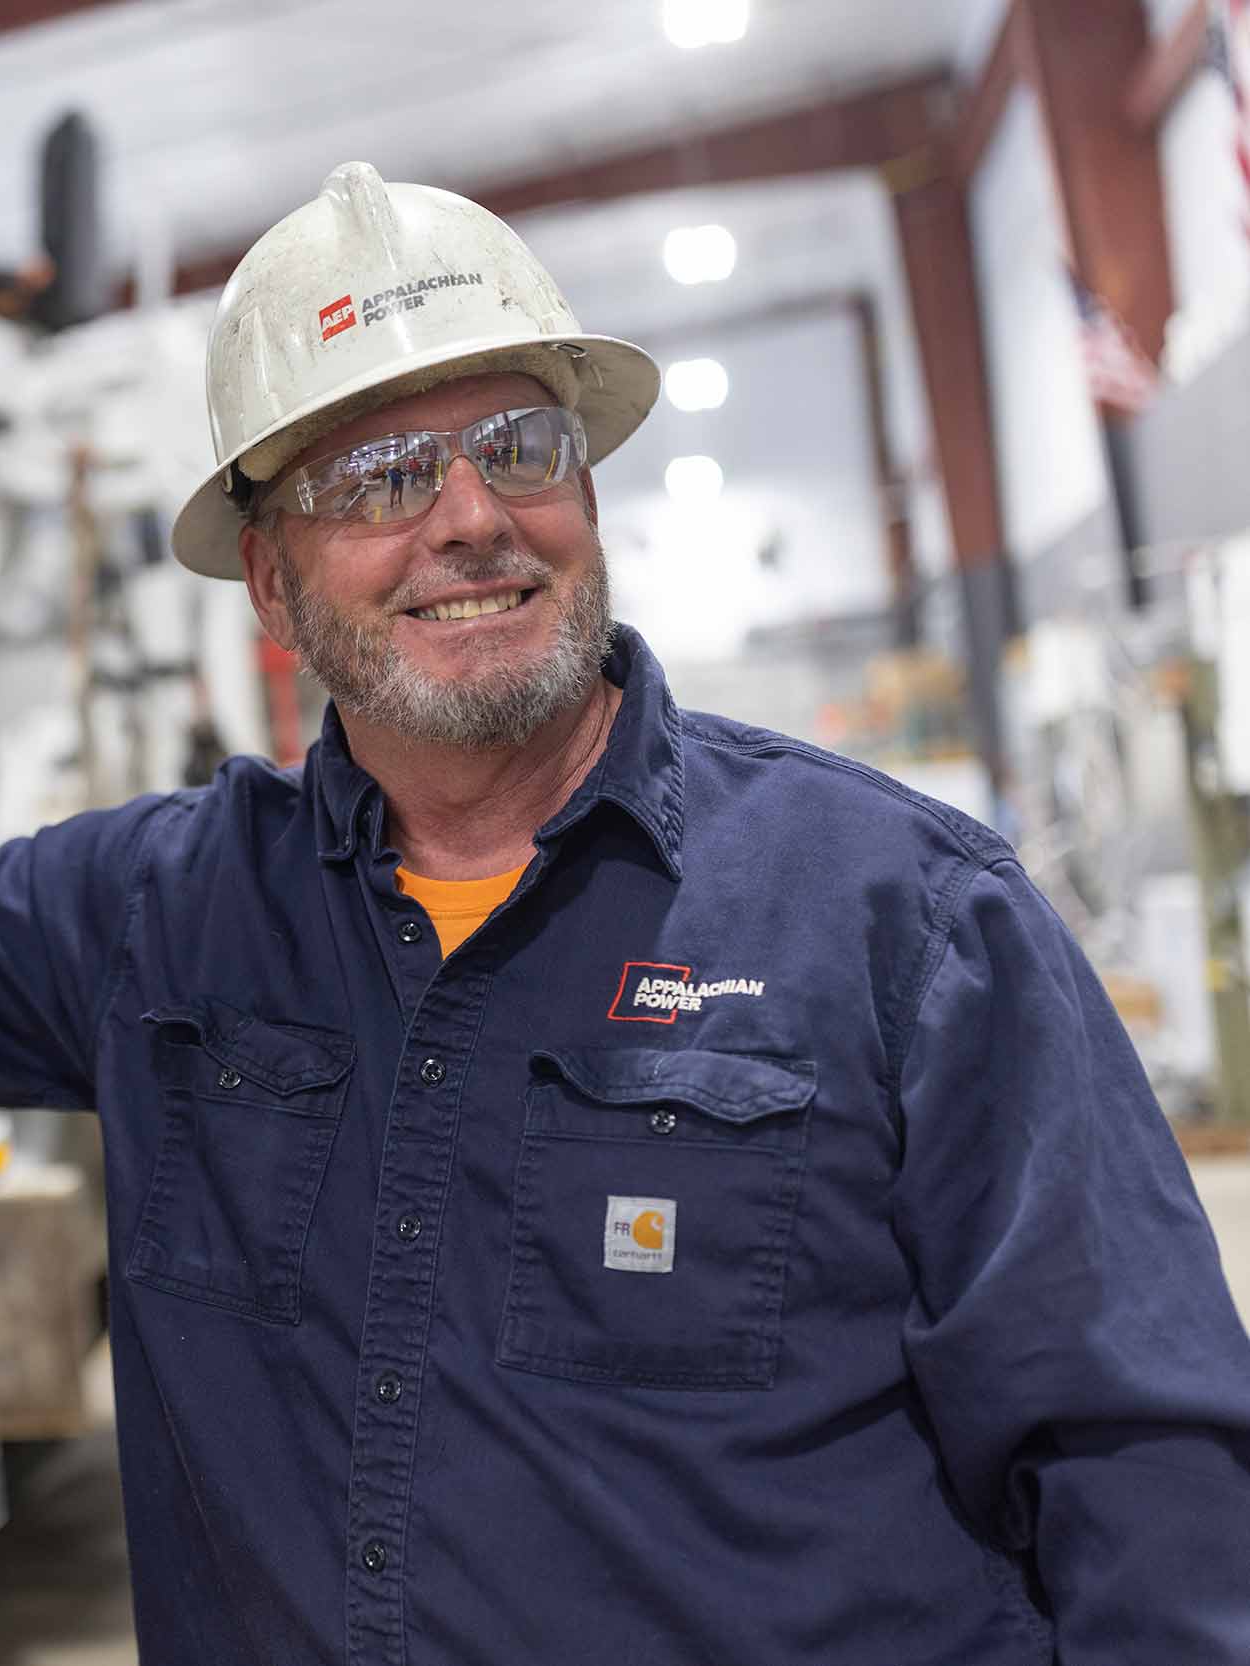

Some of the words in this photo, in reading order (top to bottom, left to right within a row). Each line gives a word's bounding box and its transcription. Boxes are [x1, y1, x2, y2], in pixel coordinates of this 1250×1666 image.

[362, 273, 483, 312] APPALACHIAN
[321, 306, 355, 329] AEP
[364, 295, 426, 326] POWER
[637, 977, 764, 998] APPALACHIAN
[633, 992, 702, 1011] POWER
[614, 1221, 631, 1236] FR
